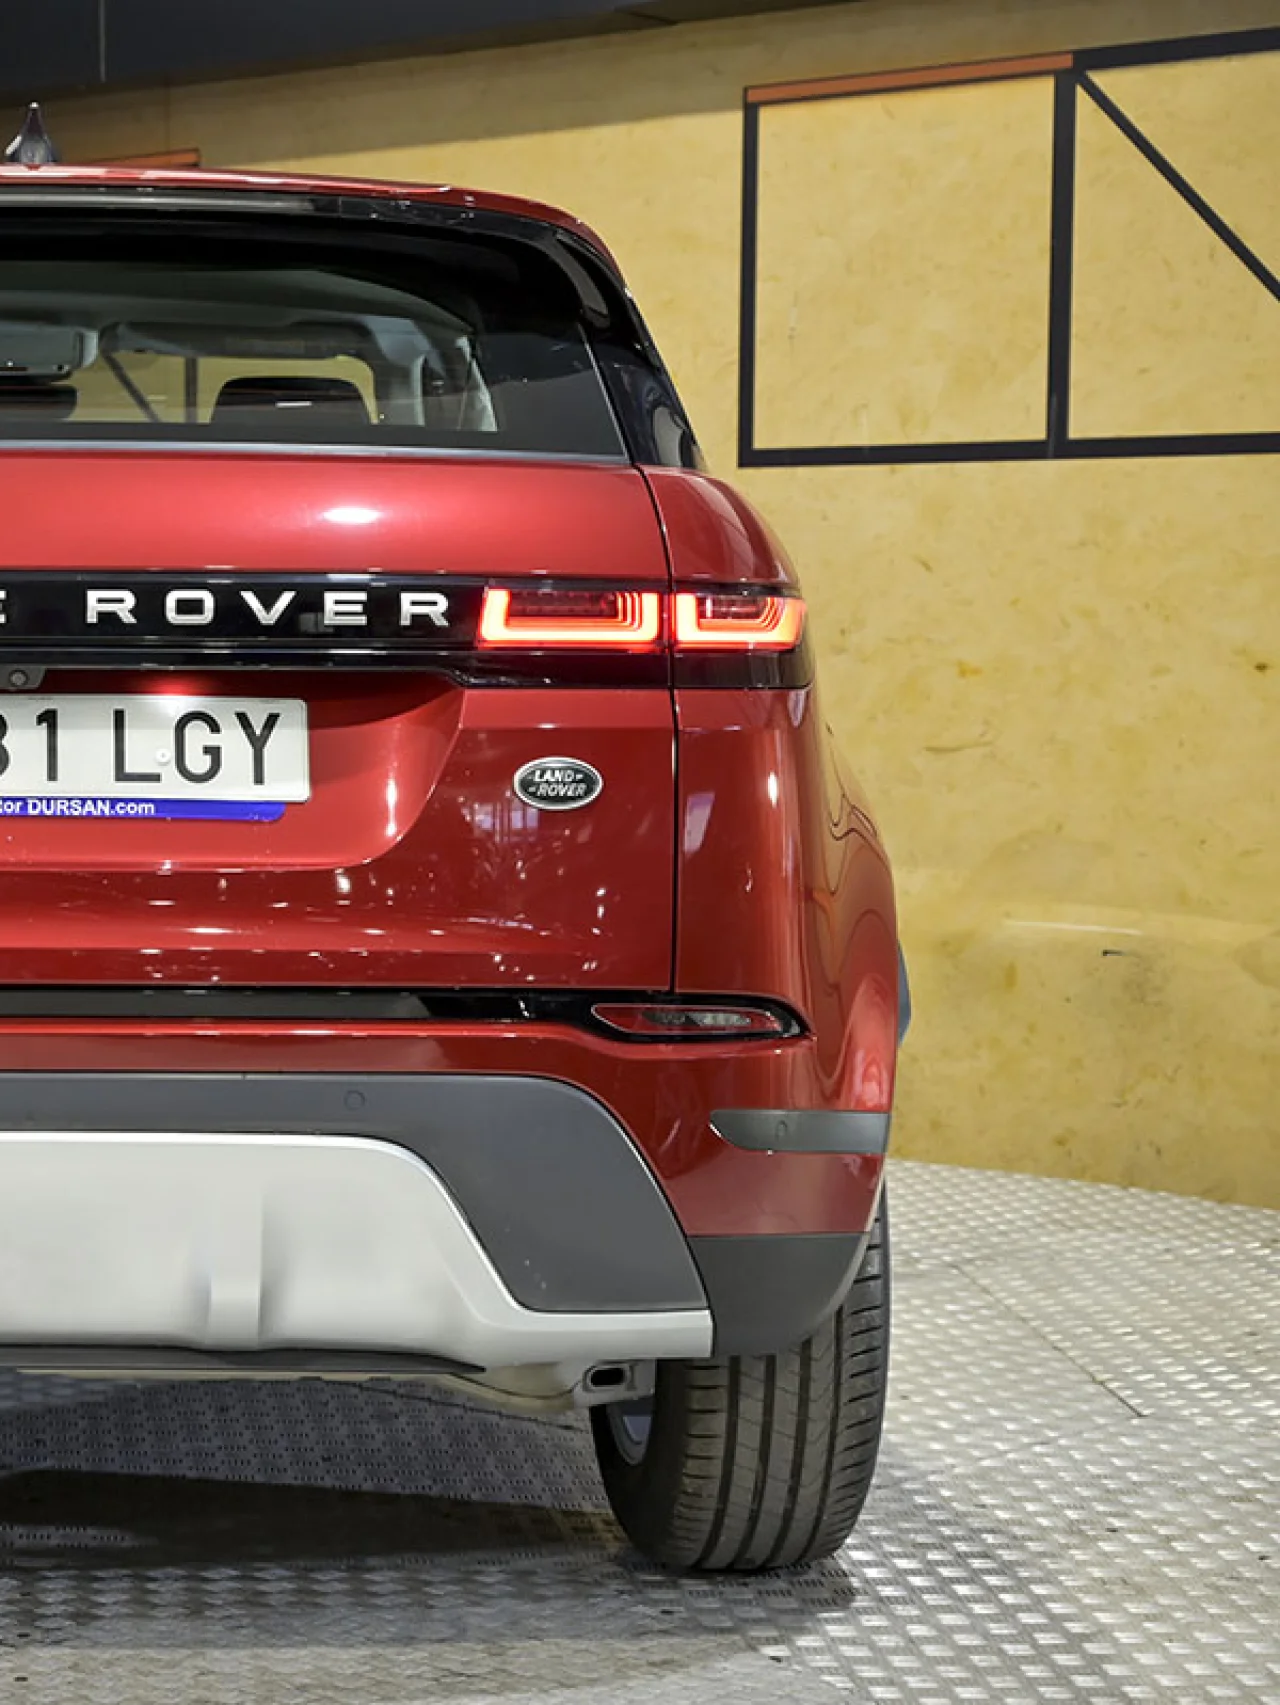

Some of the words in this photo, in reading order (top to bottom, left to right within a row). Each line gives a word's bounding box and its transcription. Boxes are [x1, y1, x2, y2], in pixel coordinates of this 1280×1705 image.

[86, 589, 450, 627] ROVER
[112, 708, 281, 785] LGY
[27, 799, 154, 817] DURSAN.com
